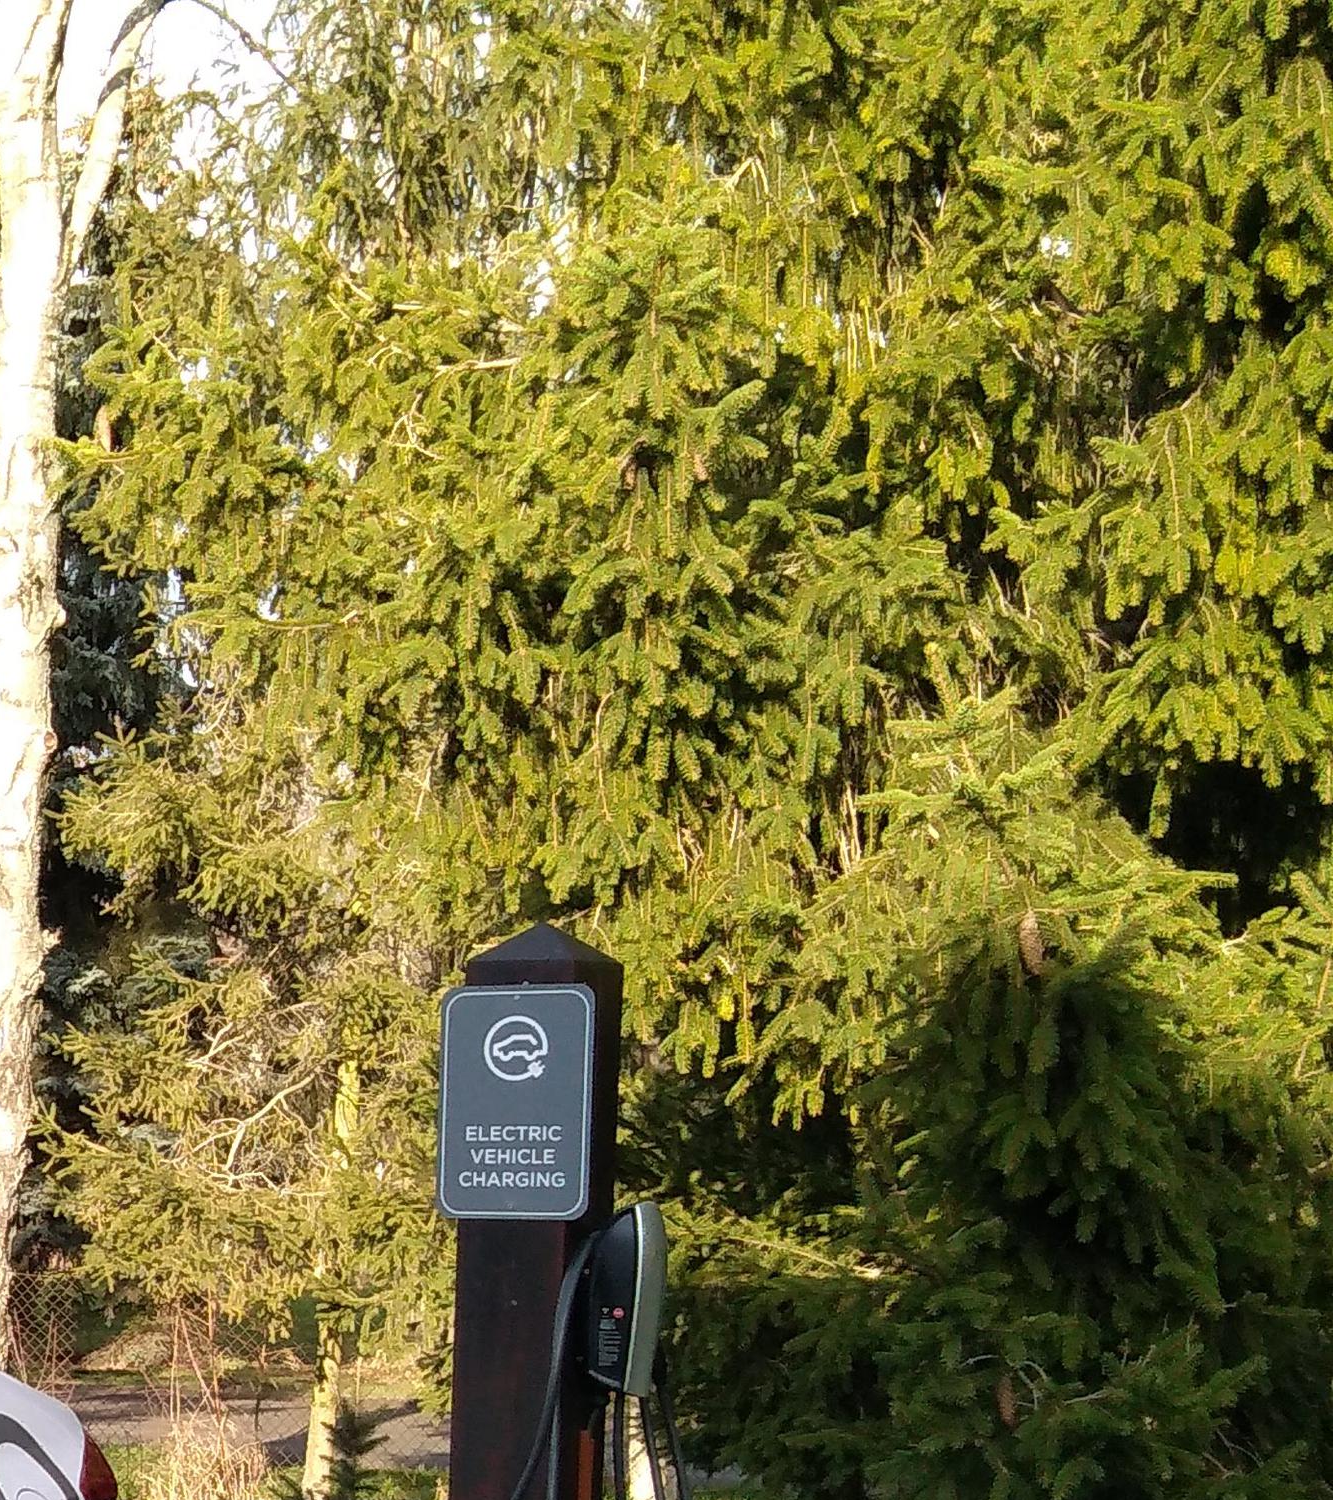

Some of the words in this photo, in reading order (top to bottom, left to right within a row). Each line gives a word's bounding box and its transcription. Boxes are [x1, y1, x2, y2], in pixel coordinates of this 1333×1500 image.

[464, 1125, 563, 1142] ELECTRIC
[470, 1148, 556, 1165] VEHICLE
[459, 1171, 566, 1188] CHARGING
